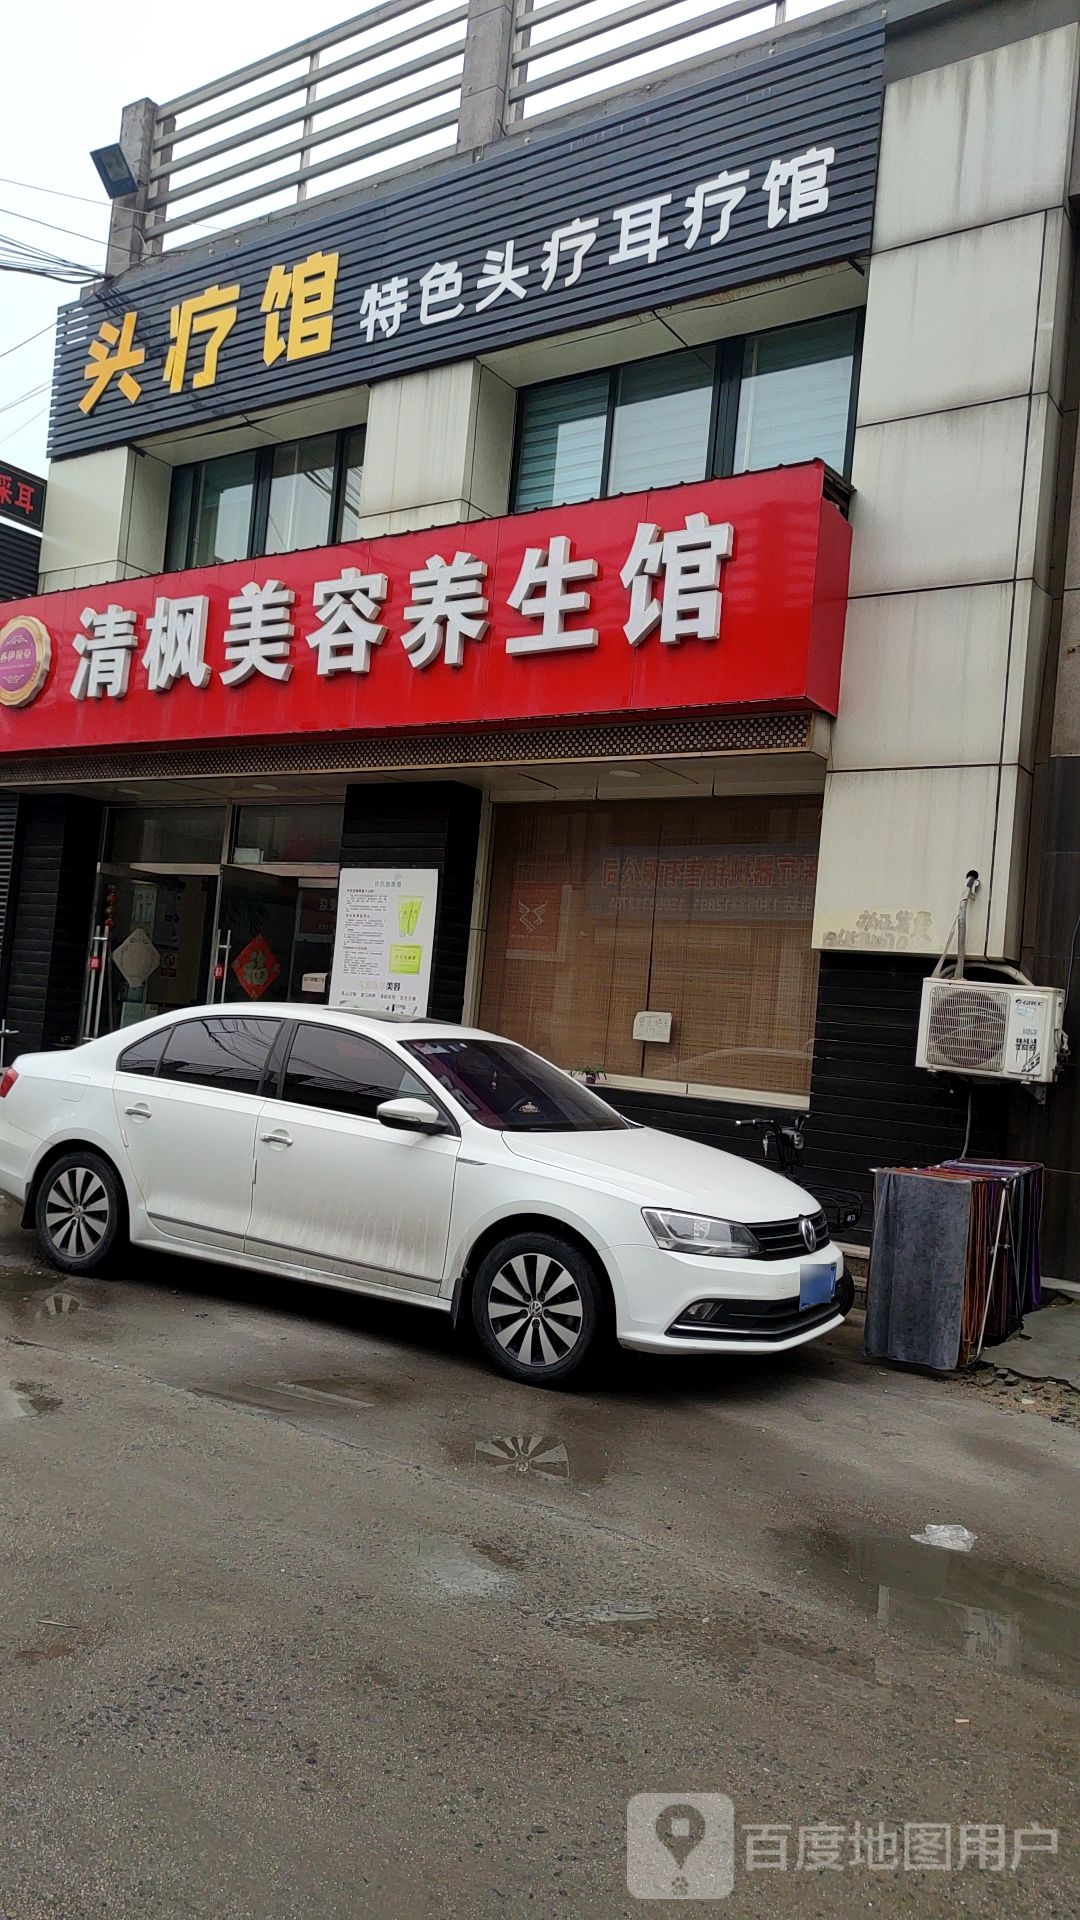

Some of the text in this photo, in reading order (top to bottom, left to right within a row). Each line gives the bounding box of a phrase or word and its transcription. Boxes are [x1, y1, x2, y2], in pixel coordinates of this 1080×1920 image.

[358, 146, 835, 343] 特色头疗耳疗馆
[78, 250, 340, 415] 头疗馆
[69, 511, 735, 701] 清枫美容养生馆
[243, 950, 269, 985] 福
[386, 981, 401, 991] 美容
